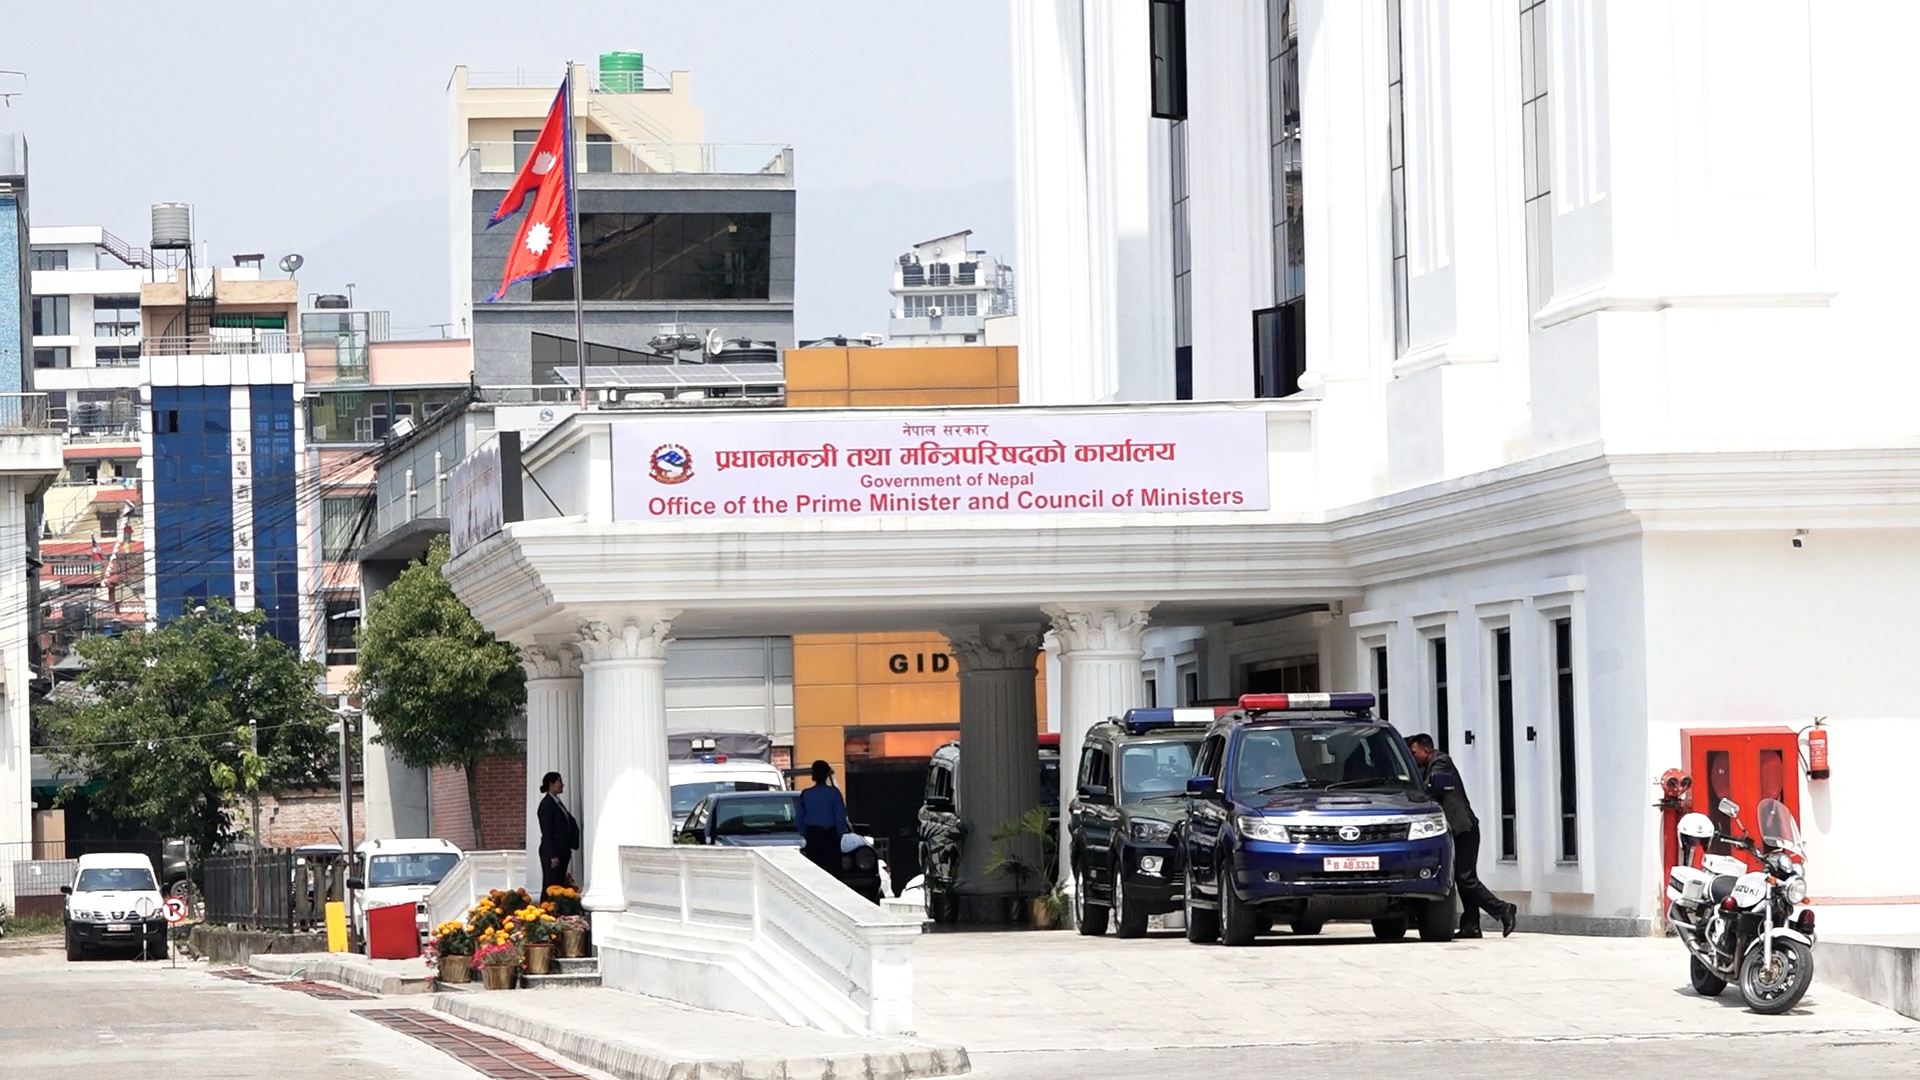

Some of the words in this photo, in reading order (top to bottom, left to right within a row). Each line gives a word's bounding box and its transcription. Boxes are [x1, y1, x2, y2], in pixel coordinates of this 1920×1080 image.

[903, 422, 936, 437] नेपाल
[943, 424, 989, 437] सरकार
[715, 443, 838, 472] प्रधानमन्त्री
[847, 447, 891, 468] तथा
[900, 439, 1066, 467] मन्त्रिपरिषदको
[1074, 438, 1176, 463] कार्यालय
[860, 474, 961, 488] Government
[967, 473, 983, 486] of
[988, 473, 1034, 488] Nepal
[648, 497, 716, 516] Office
[724, 496, 746, 514] of
[753, 496, 789, 514] the
[796, 494, 862, 513] Prime
[870, 493, 961, 512] Minister
[967, 492, 1010, 511] and
[1017, 490, 1104, 509] Council
[1111, 489, 1134, 507] of
[1141, 488, 1244, 507] Ministers
